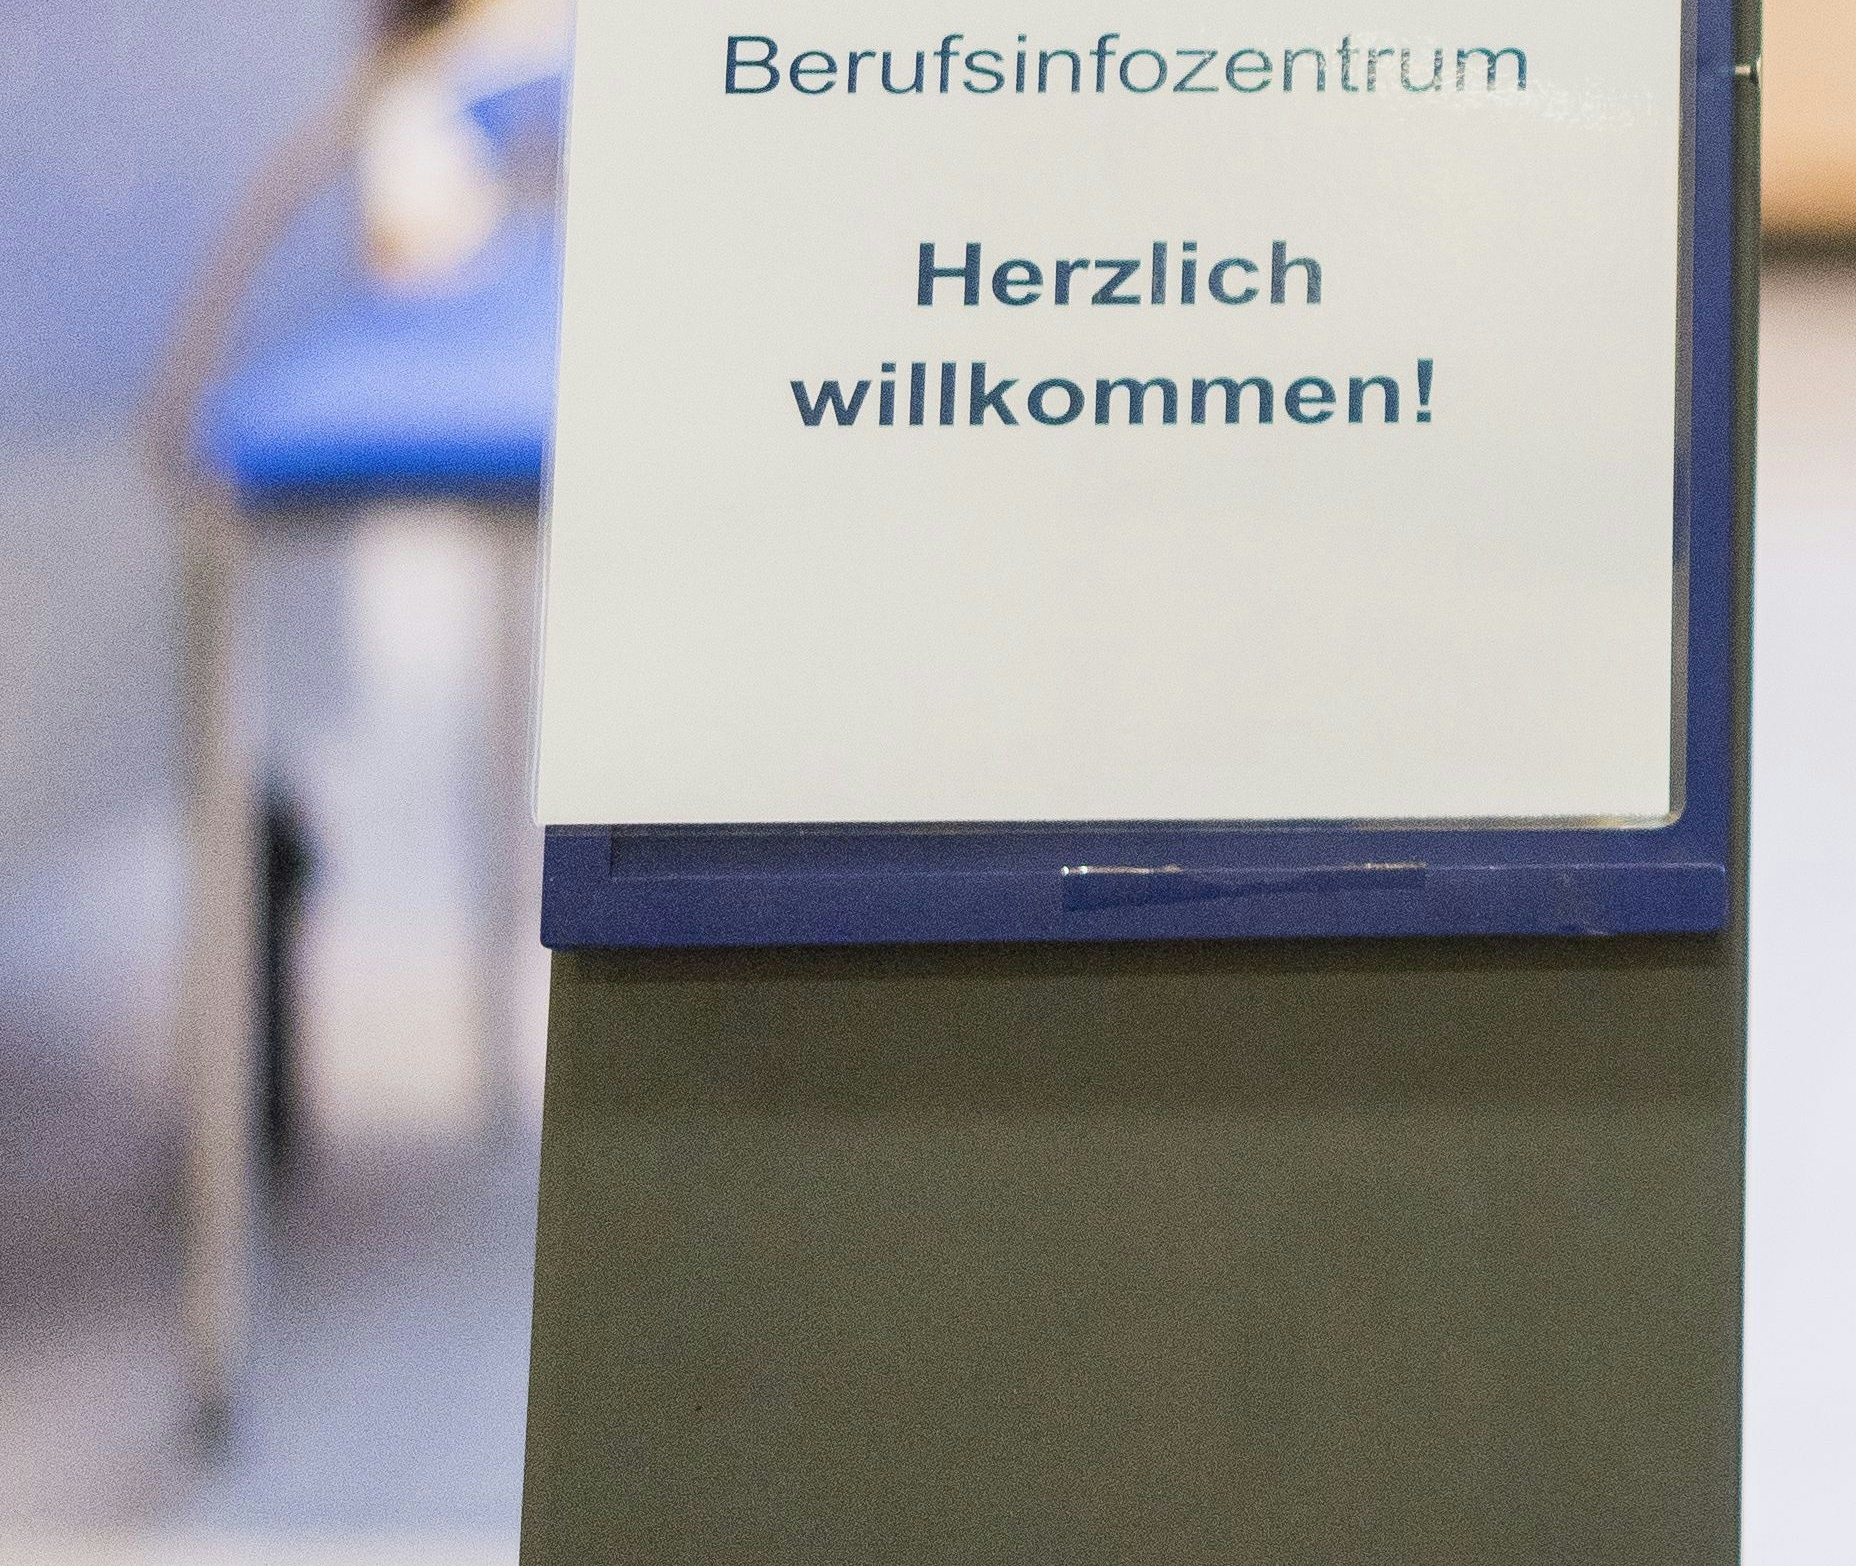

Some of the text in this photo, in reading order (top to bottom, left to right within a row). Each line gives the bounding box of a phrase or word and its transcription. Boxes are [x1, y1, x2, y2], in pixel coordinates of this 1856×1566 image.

[725, 32, 1527, 96] Berufsinfozentrum
[917, 240, 1322, 307] Herzlich
[790, 358, 1434, 427] willkommen!
